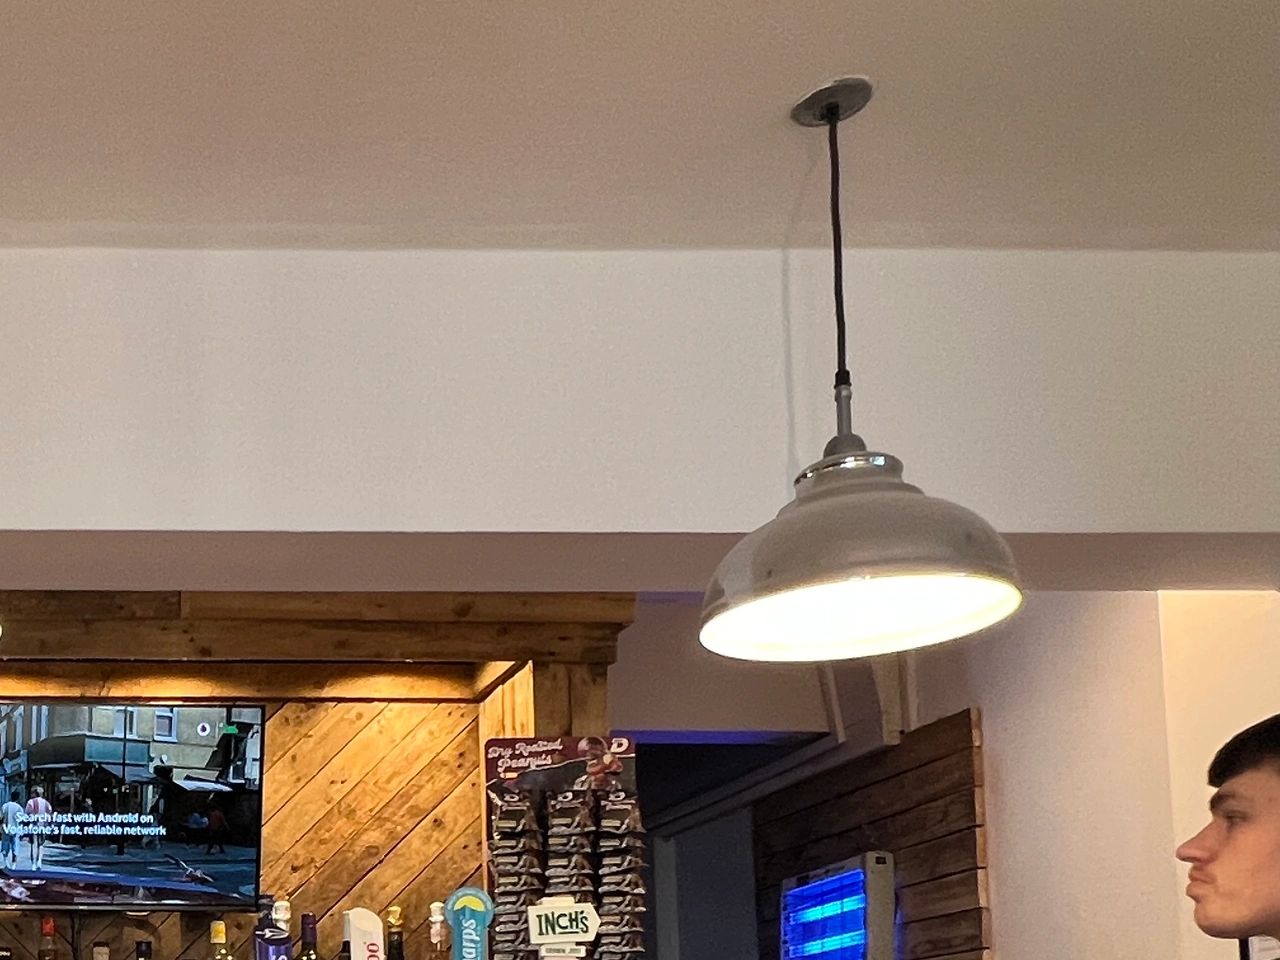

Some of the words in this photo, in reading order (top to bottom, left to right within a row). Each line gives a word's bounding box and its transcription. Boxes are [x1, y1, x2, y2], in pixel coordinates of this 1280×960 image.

[487, 746, 514, 760] Dry
[515, 738, 564, 757] Roasted
[497, 754, 553, 774] Peanuts
[16, 812, 52, 823] Search
[52, 812, 72, 823] fast
[73, 812, 96, 823] with
[97, 812, 139, 823] Android
[140, 814, 154, 823] on
[3, 824, 59, 835] Vodafone's
[60, 824, 83, 836] fast,
[83, 825, 122, 836] reliable
[123, 825, 167, 836] network
